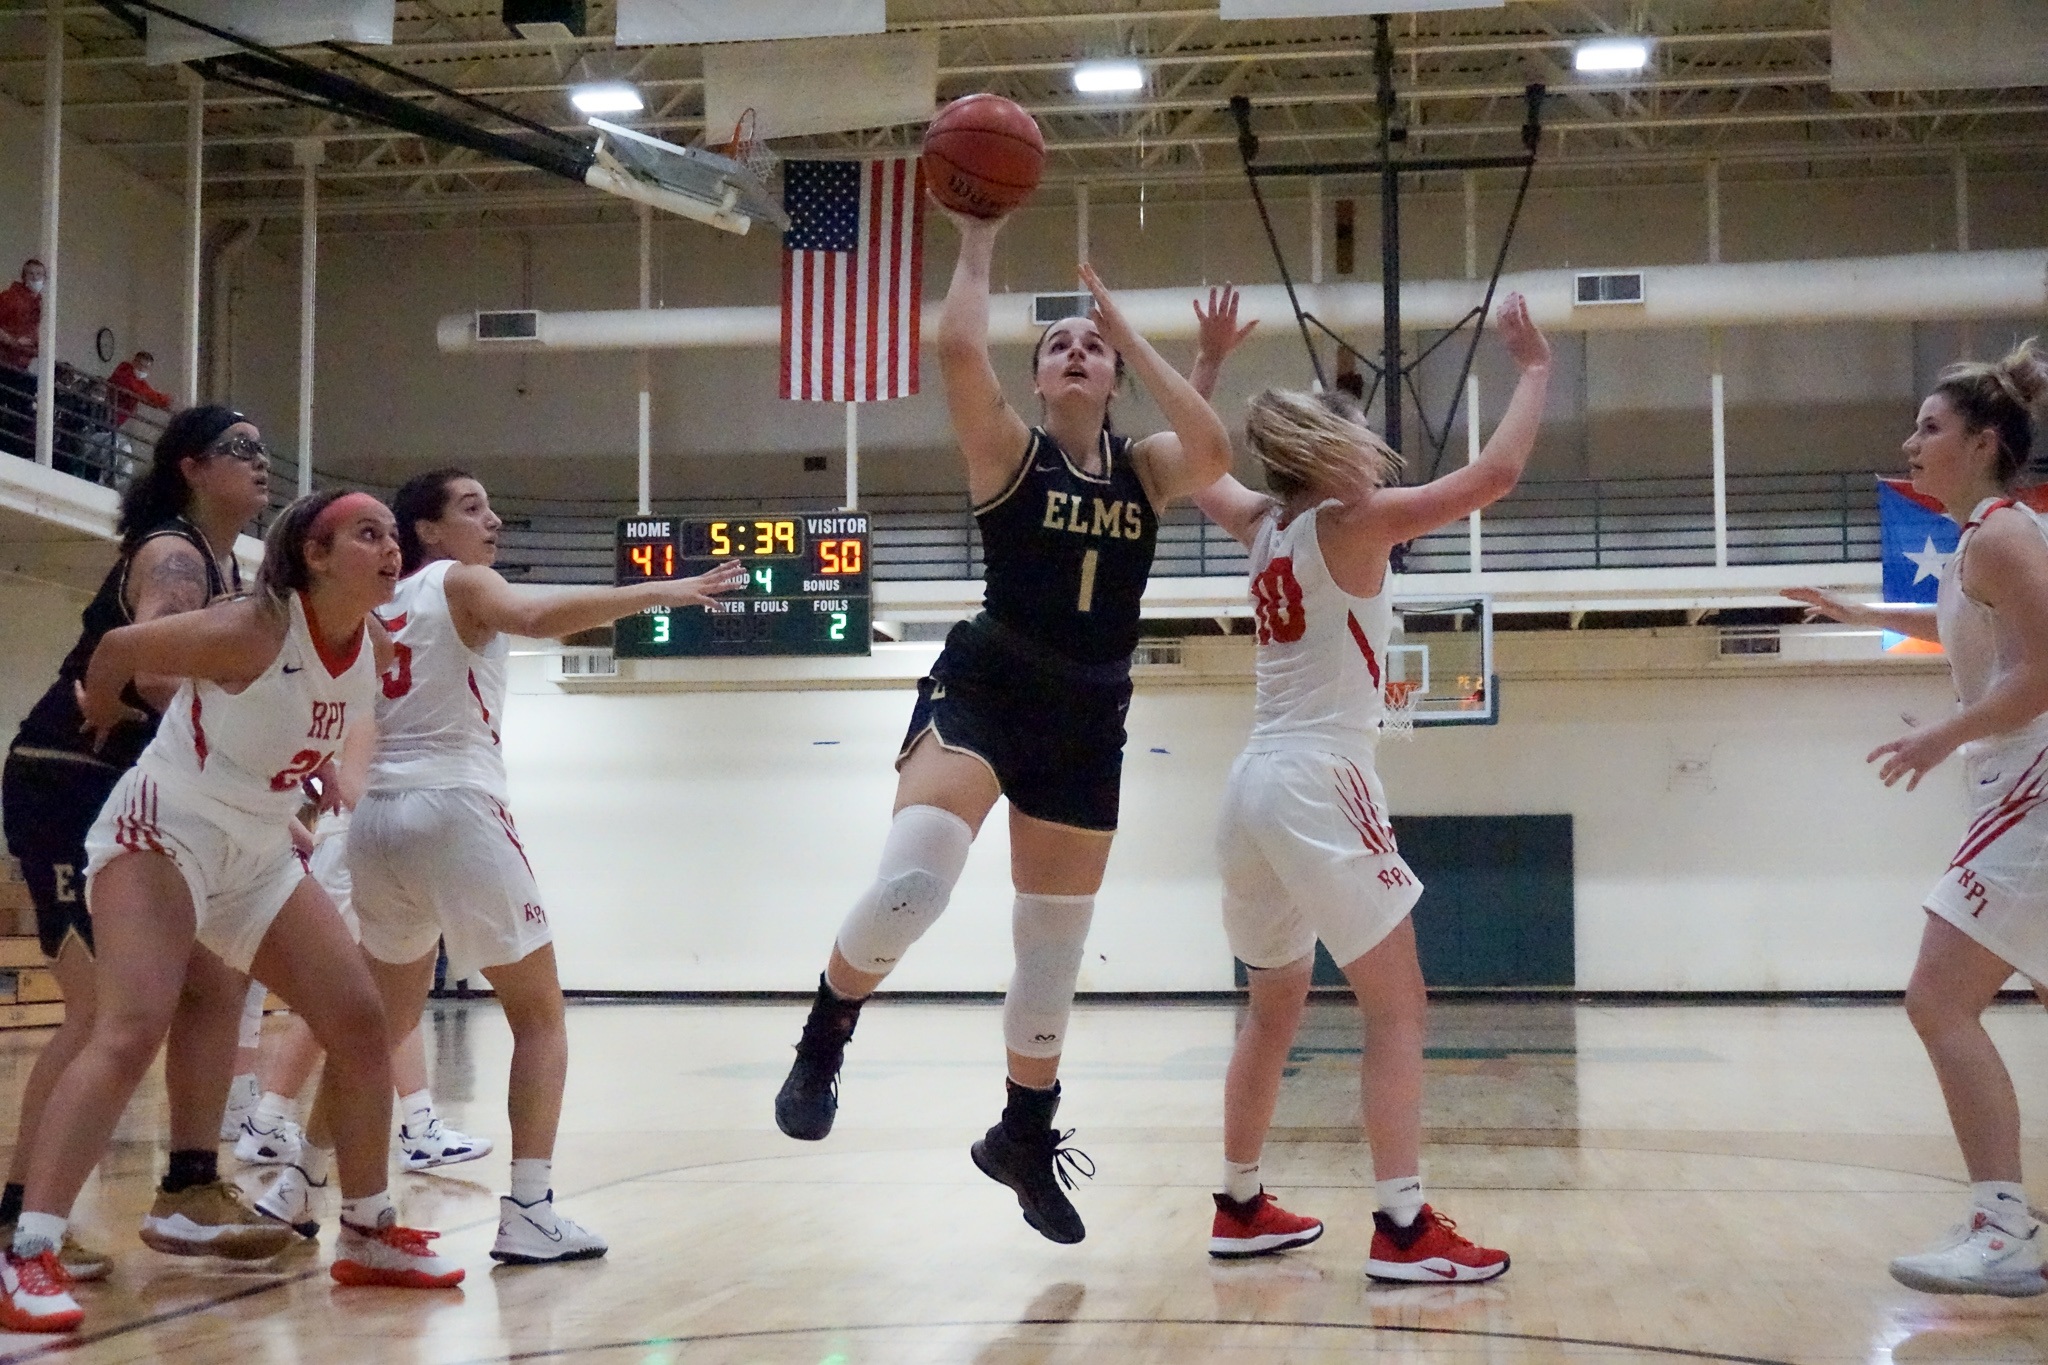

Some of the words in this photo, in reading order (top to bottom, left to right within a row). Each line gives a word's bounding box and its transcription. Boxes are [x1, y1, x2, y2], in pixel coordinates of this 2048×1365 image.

[807, 518, 867, 534] VISITOR
[1043, 490, 1142, 540] ELMS
[627, 522, 671, 538] HOME
[711, 521, 794, 555] 5:39
[632, 544, 673, 576] 41
[820, 540, 861, 573] 50
[756, 567, 772, 594] 4
[803, 579, 840, 592] BONUS
[1078, 549, 1099, 612] 1
[637, 604, 671, 614] OULS
[754, 601, 789, 613] FOULS
[813, 600, 849, 612] FOULS
[653, 616, 670, 642] 3
[830, 613, 847, 640] 2
[306, 700, 346, 740] RPI
[270, 749, 328, 792] 2
[53, 863, 76, 902] E
[1377, 866, 1412, 890] RPI
